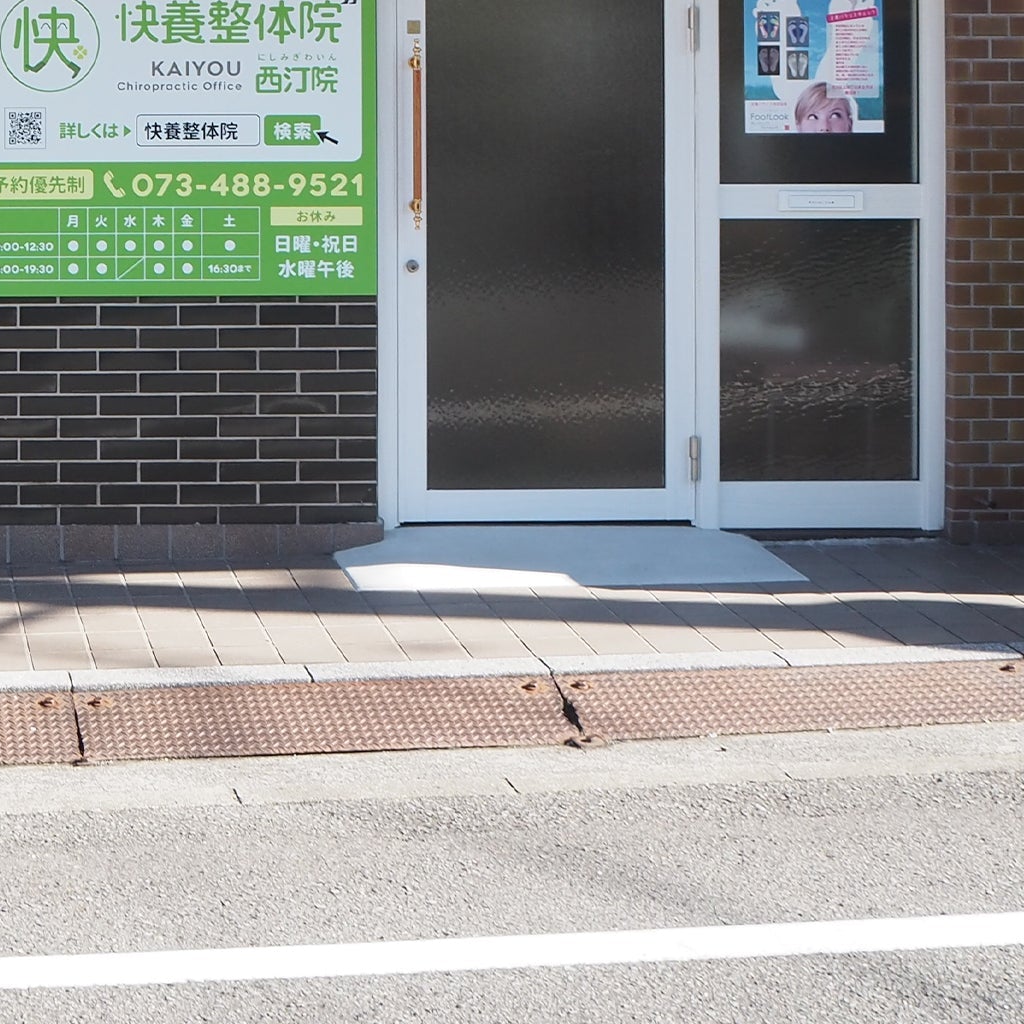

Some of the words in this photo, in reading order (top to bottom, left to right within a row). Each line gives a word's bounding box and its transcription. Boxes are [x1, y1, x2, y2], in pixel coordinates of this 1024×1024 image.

[115, 0, 343, 44] 快養整体院
[151, 60, 242, 77] KAIYOU
[117, 81, 199, 94] Chiropractic
[202, 81, 243, 92] Office
[256, 65, 339, 93] 西汀院
[59, 122, 119, 140] 詳しくは
[144, 121, 238, 142] 快養整体院
[273, 121, 312, 142] 検索
[132, 173, 363, 197] 073-488-9521
[66, 215, 79, 229] 月
[95, 216, 108, 228] 火
[123, 215, 137, 228] 水
[151, 215, 165, 228] 木
[180, 215, 194, 228] 金
[223, 215, 236, 228] 土
[296, 210, 336, 223] お休み
[275, 236, 358, 253] 日曜・祝日
[278, 259, 355, 279] 水曜午後
